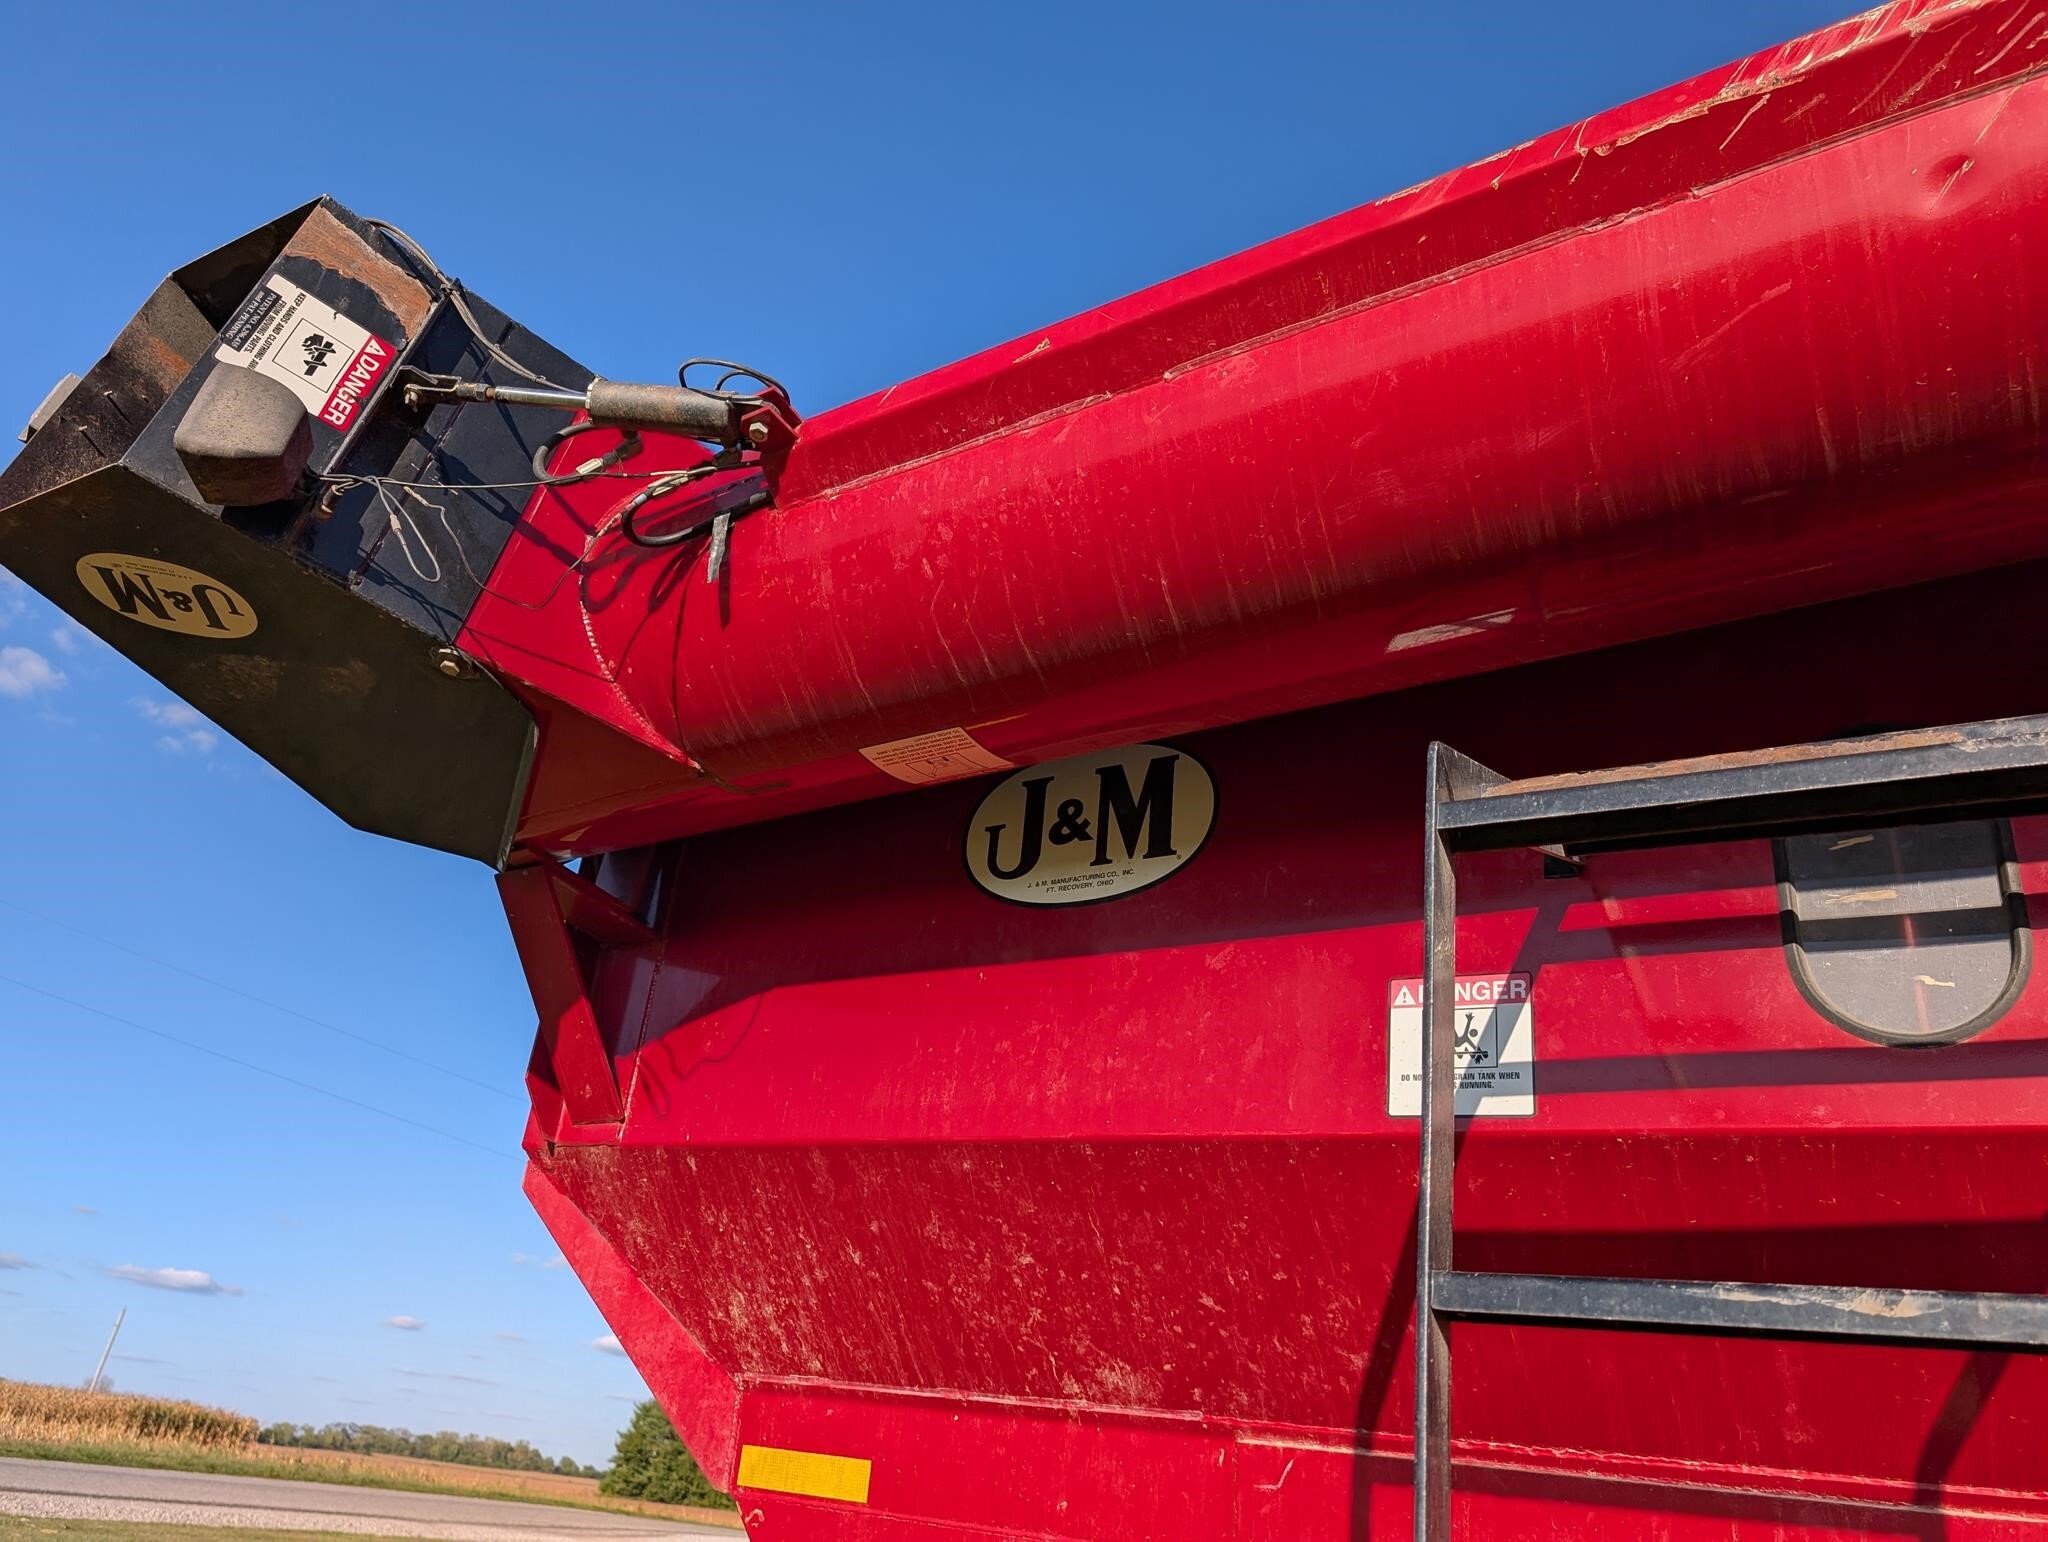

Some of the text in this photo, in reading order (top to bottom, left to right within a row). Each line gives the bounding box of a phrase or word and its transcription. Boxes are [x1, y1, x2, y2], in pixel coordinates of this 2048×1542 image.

[257, 292, 277, 316] PATENT
[294, 292, 307, 307] KEEP
[226, 290, 265, 340] and PAT. PENDING
[248, 314, 260, 325] NO.
[280, 305, 298, 324] HANDS
[244, 300, 287, 354] FROM MOVING PARTS.
[272, 322, 284, 336] AND
[254, 334, 276, 360] CLOTHING
[323, 356, 380, 426] DANGER
[91, 564, 245, 632] J&M
[985, 754, 1180, 880] J&M
[1051, 872, 1106, 886] MANUFACTURING
[1058, 880, 1095, 892] RECOVERY,
[1418, 979, 1526, 1003] NGER
[1454, 1073, 1475, 1081] GRAIN
[1478, 1072, 1496, 1080] TANK
[1498, 1071, 1520, 1080] WHEN
[1459, 1081, 1495, 1089] RUNNING.
